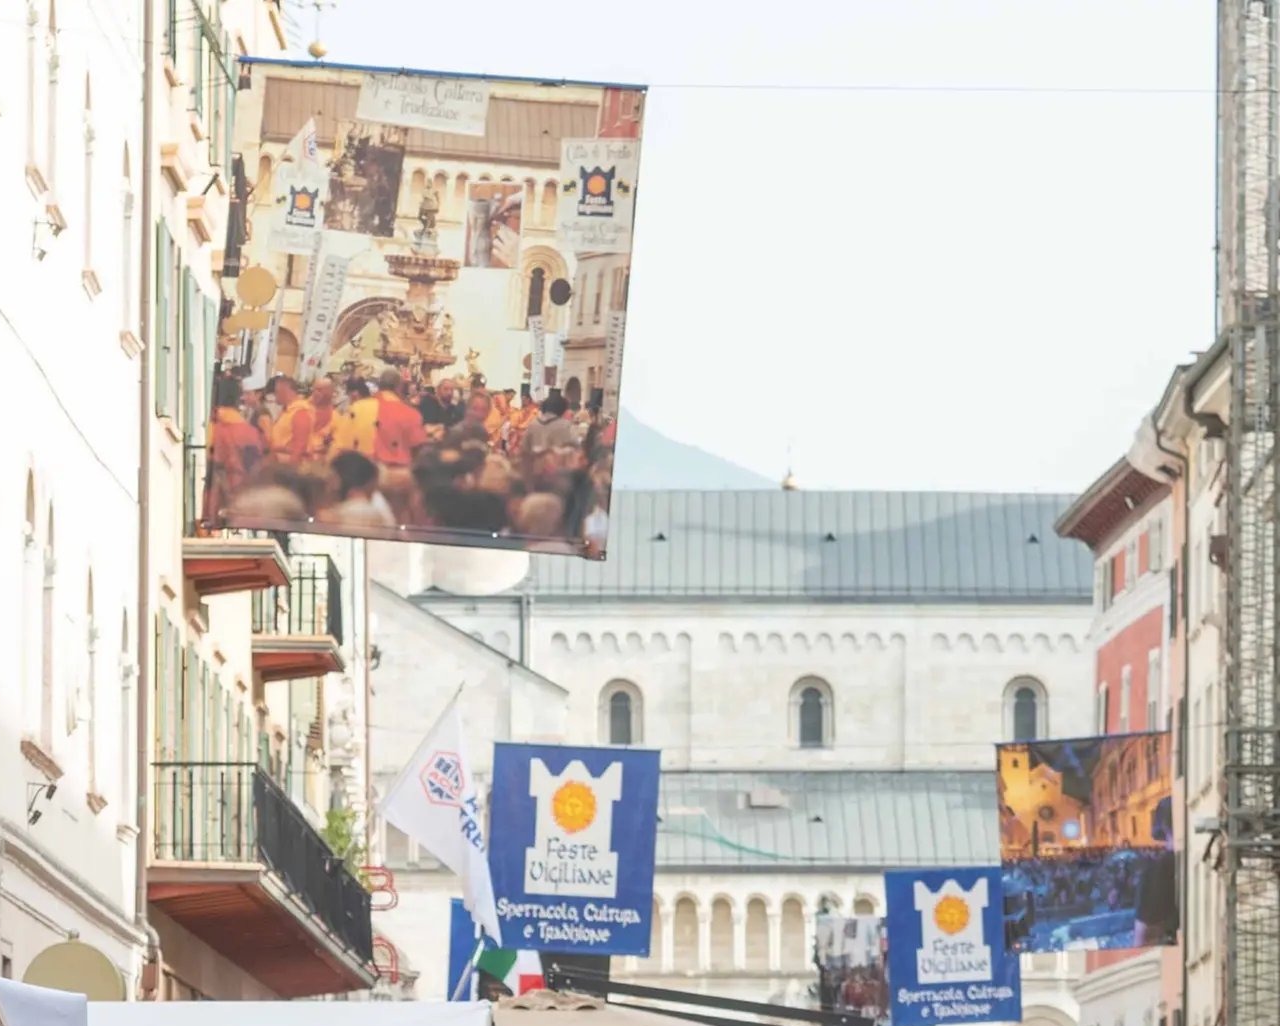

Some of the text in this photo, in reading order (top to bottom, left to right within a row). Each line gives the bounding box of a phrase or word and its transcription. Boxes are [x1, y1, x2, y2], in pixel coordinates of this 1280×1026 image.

[547, 837, 599, 861] Feste
[529, 861, 613, 892] Vigiliane
[497, 897, 641, 928] Spettacolo, Cultura
[522, 920, 612, 946] e Tradizione
[932, 938, 976, 956] Feste
[920, 955, 988, 980] Vigiliane
